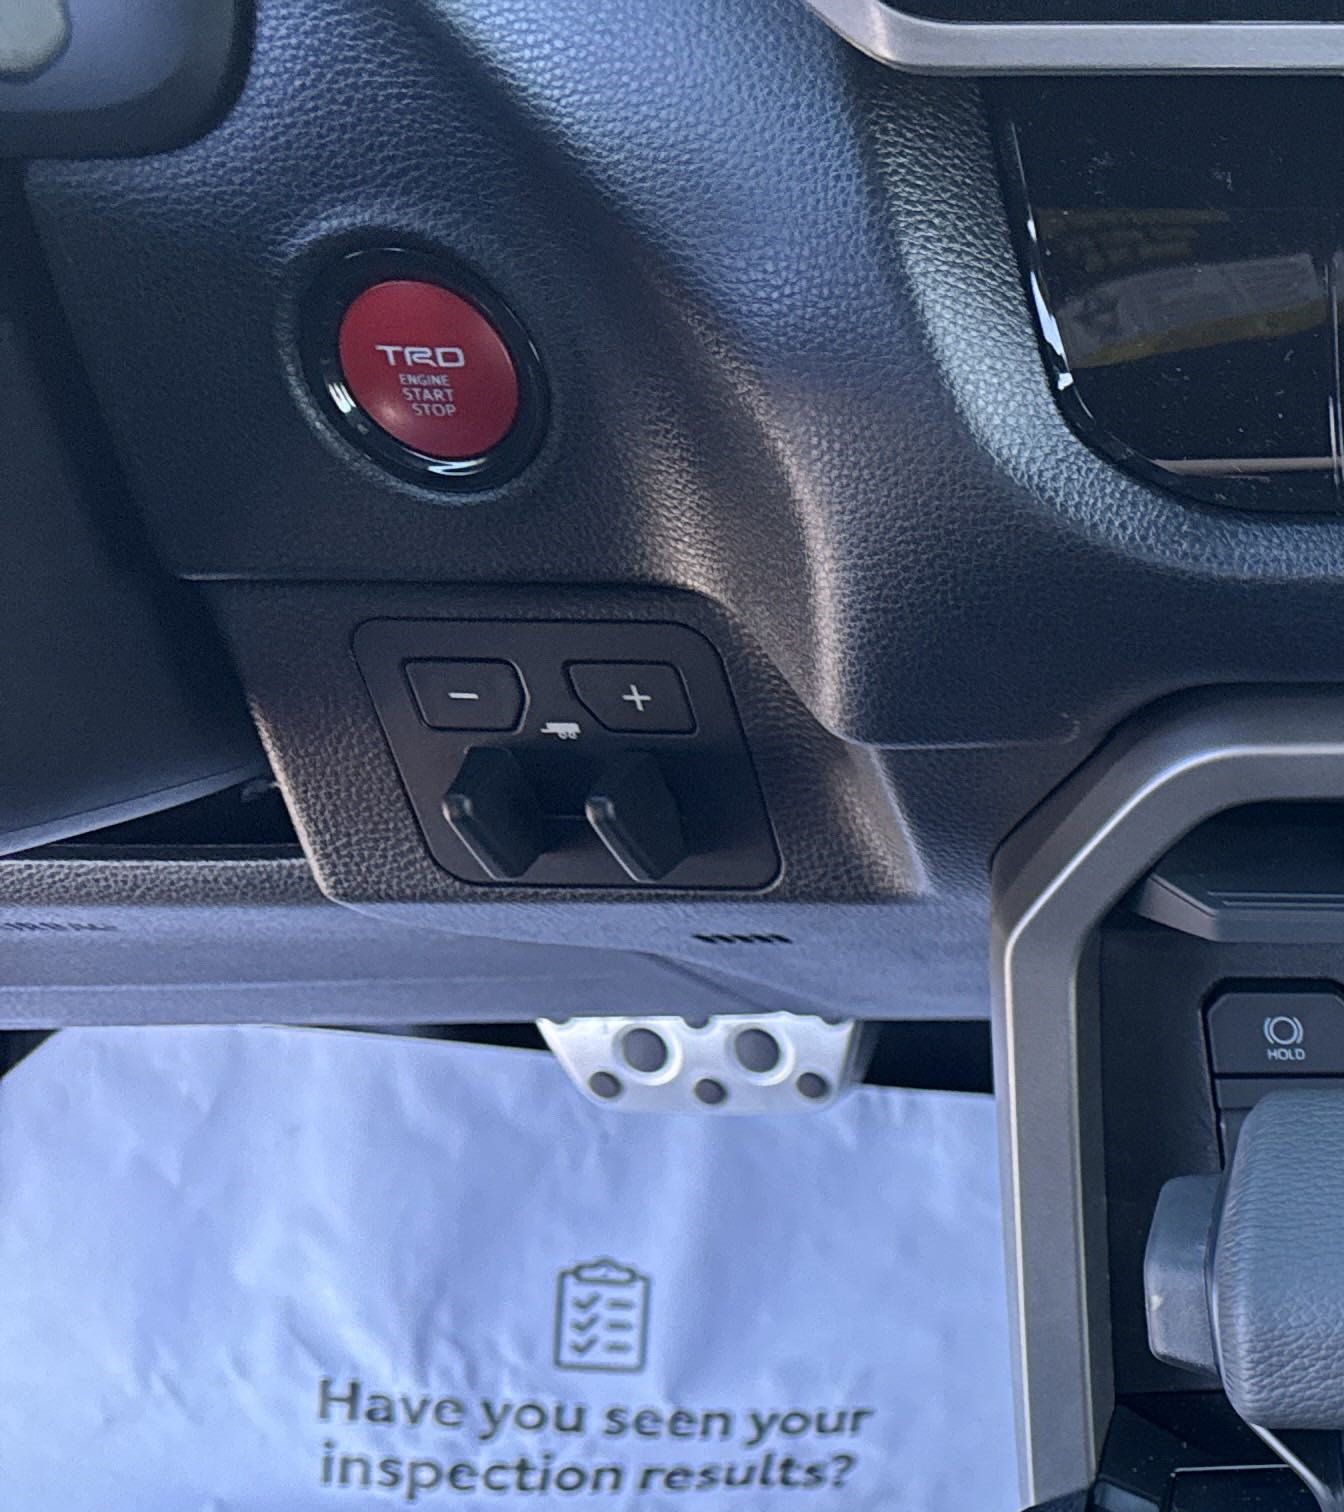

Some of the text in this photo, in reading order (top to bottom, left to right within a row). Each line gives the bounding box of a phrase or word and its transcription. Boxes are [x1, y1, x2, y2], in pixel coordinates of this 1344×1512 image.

[376, 345, 465, 368] TRD
[400, 374, 450, 387] ENGINE
[402, 387, 455, 403] START
[411, 402, 457, 417] STOP
[1266, 1048, 1307, 1062] HOLD
[318, 1377, 874, 1447] Have you seen your
[319, 1441, 856, 1502] inspection results?
